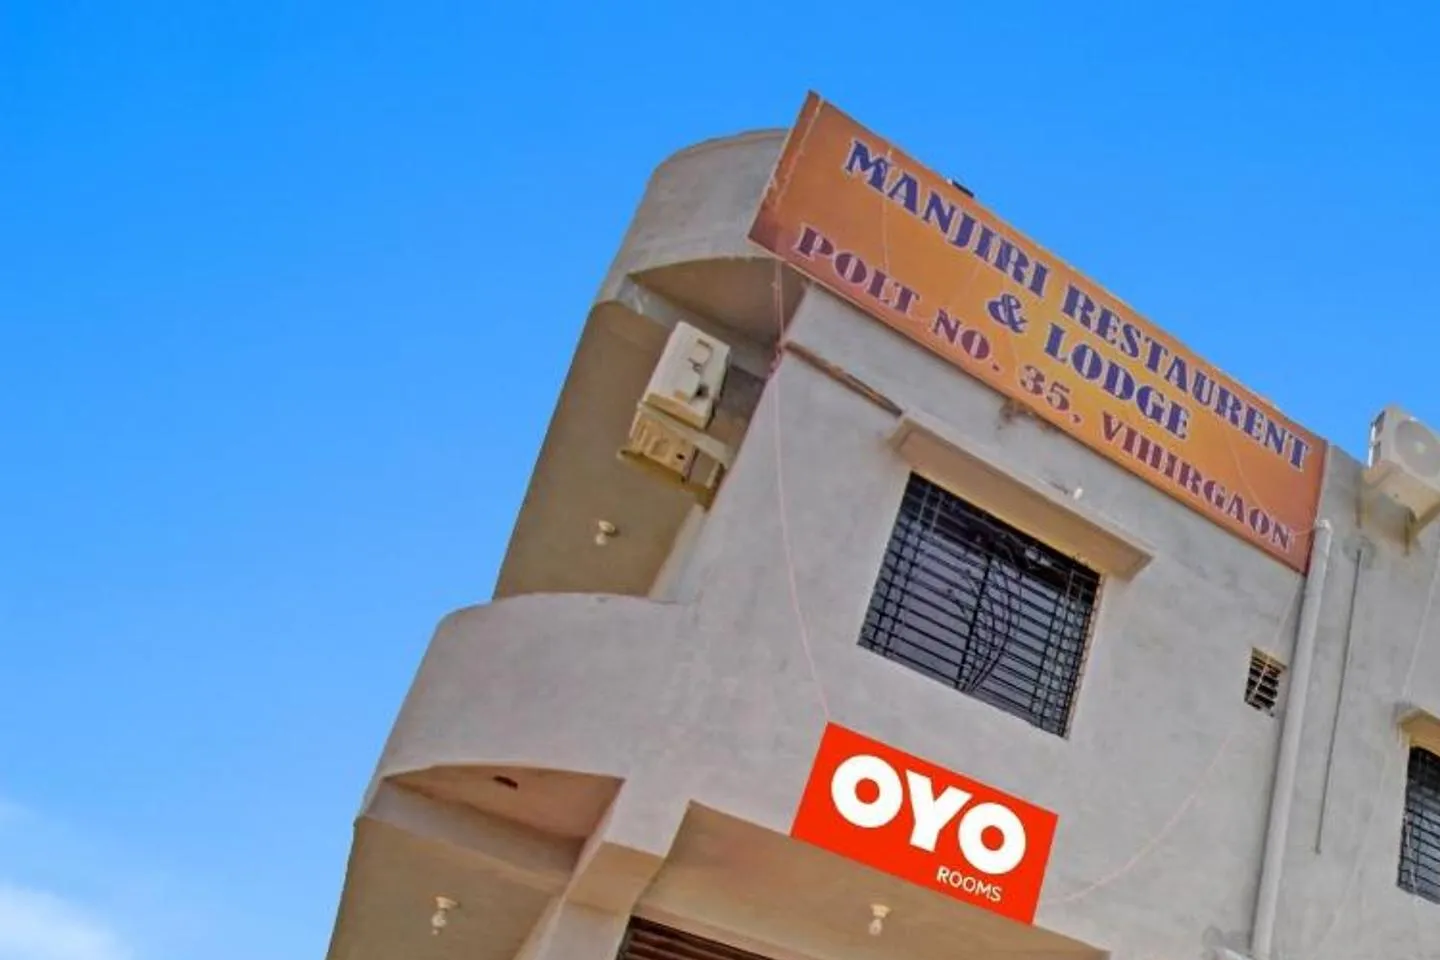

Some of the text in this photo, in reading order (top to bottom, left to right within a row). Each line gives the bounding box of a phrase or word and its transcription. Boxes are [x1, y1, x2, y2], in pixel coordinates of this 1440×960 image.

[842, 137, 1311, 471] MANJIRI RESTAURENT
[987, 292, 1192, 441] & LODGE
[793, 223, 921, 316] POLT
[931, 308, 1001, 373] NO.
[1102, 409, 1297, 551] VIHIRGAON
[831, 754, 1026, 875] OYO
[936, 865, 1002, 902] ROOMS
